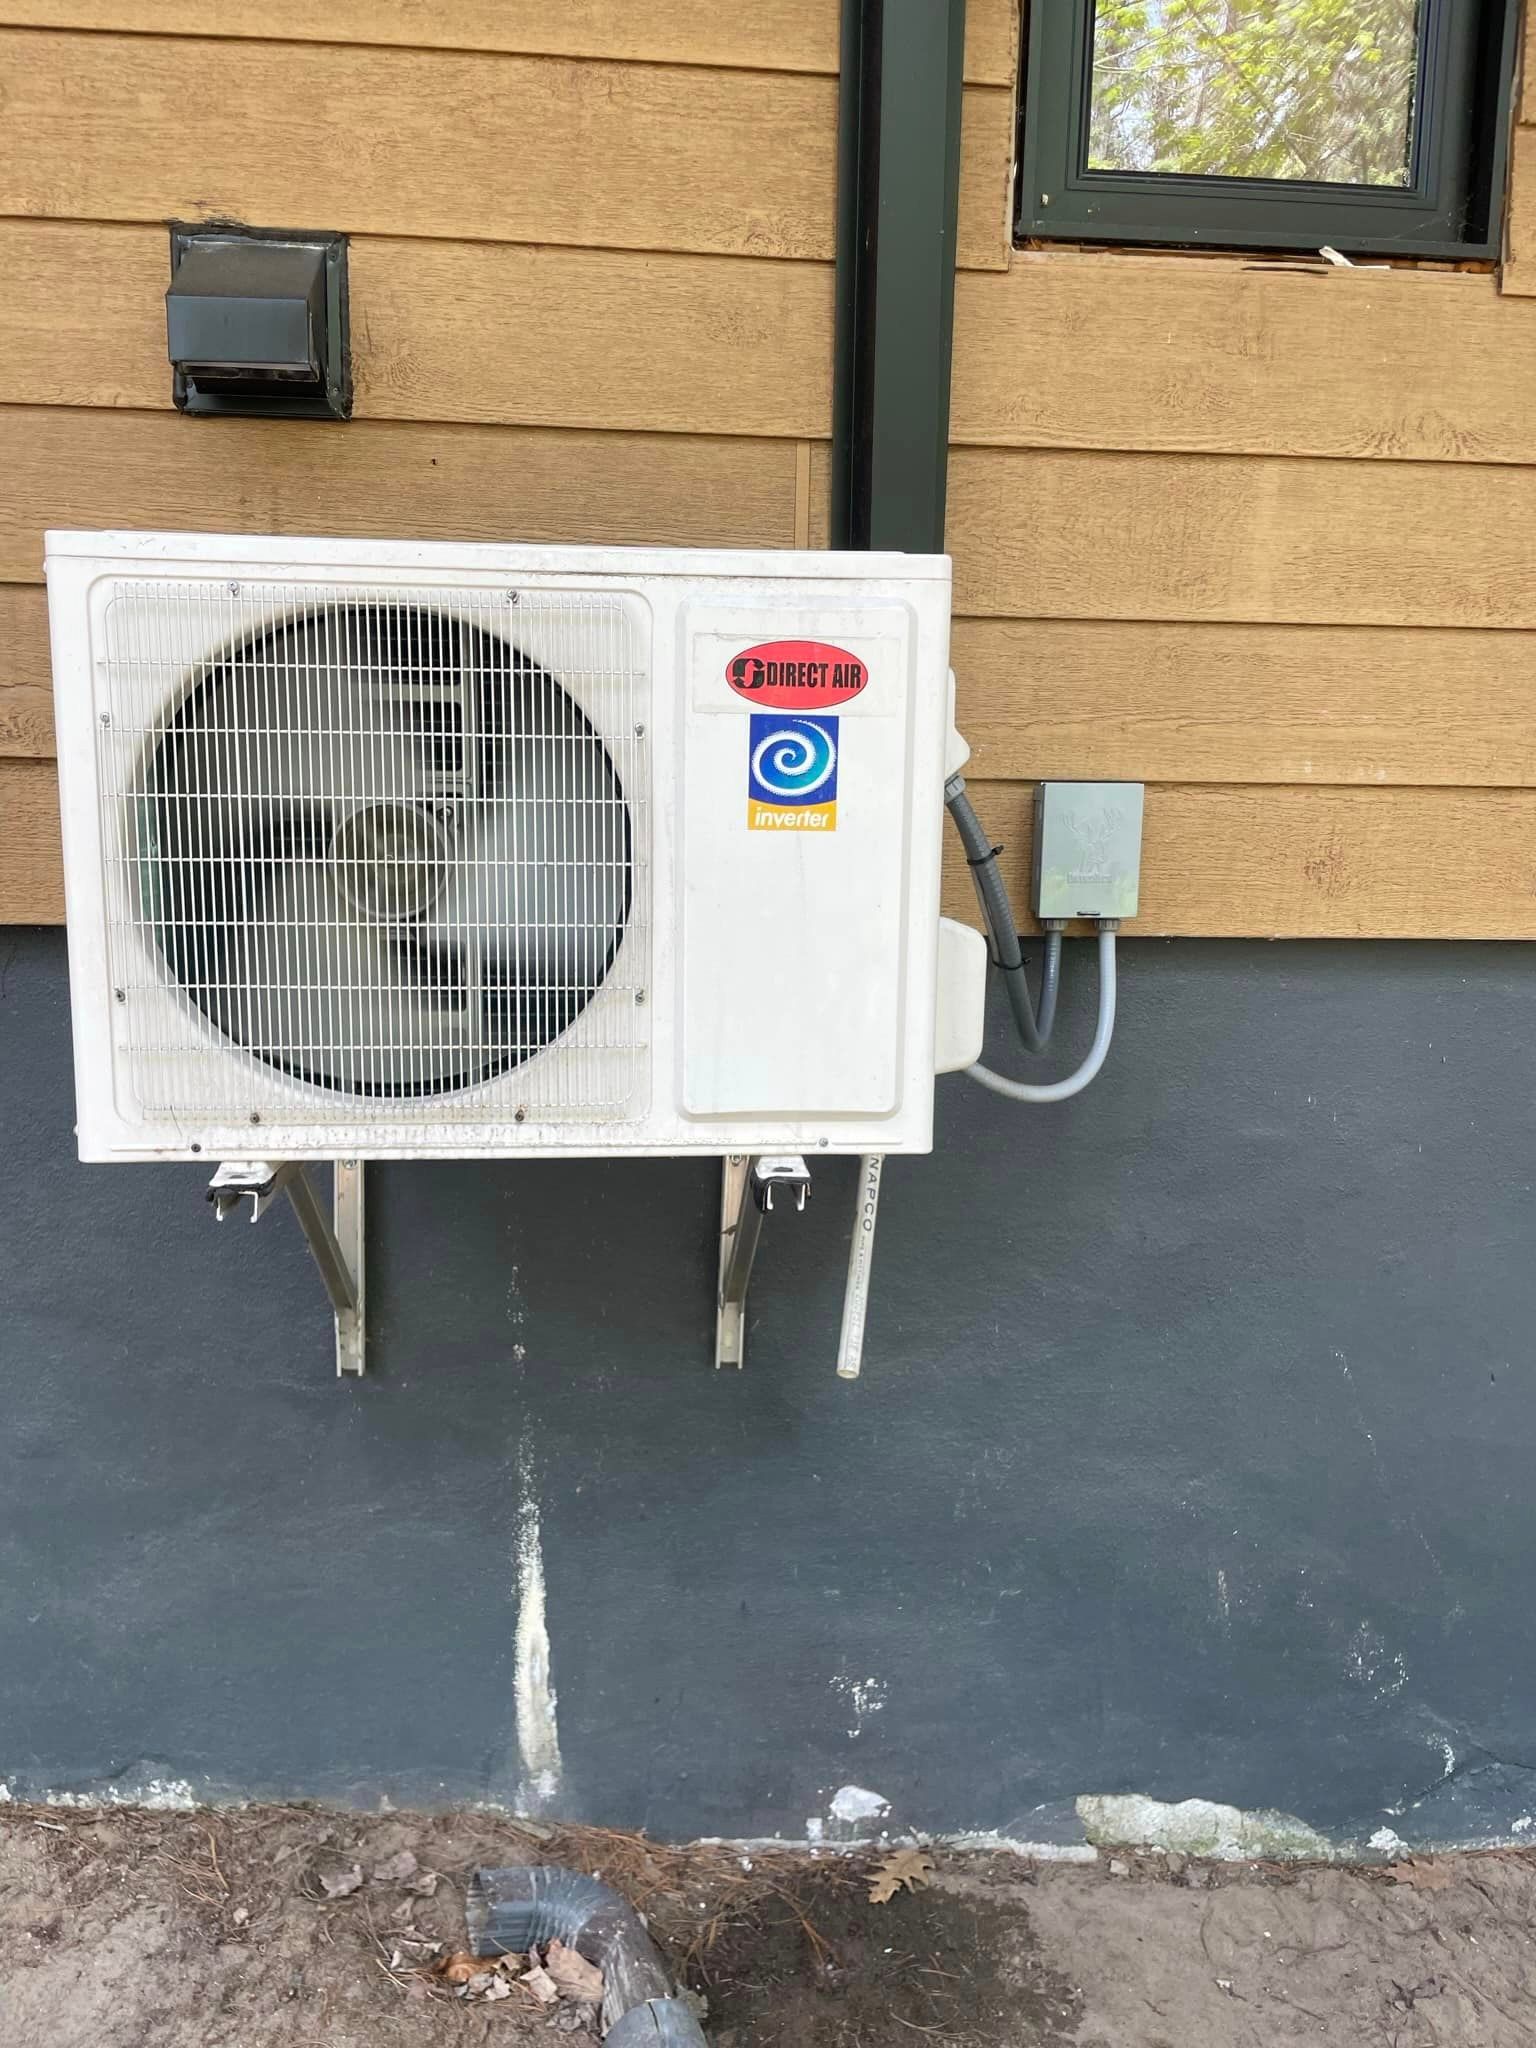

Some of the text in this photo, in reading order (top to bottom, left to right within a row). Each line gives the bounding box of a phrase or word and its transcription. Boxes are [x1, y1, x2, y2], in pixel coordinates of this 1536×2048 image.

[766, 662, 861, 688] DIRECT AIR
[754, 807, 829, 828] inverter
[862, 1157, 881, 1233] NAPCO
